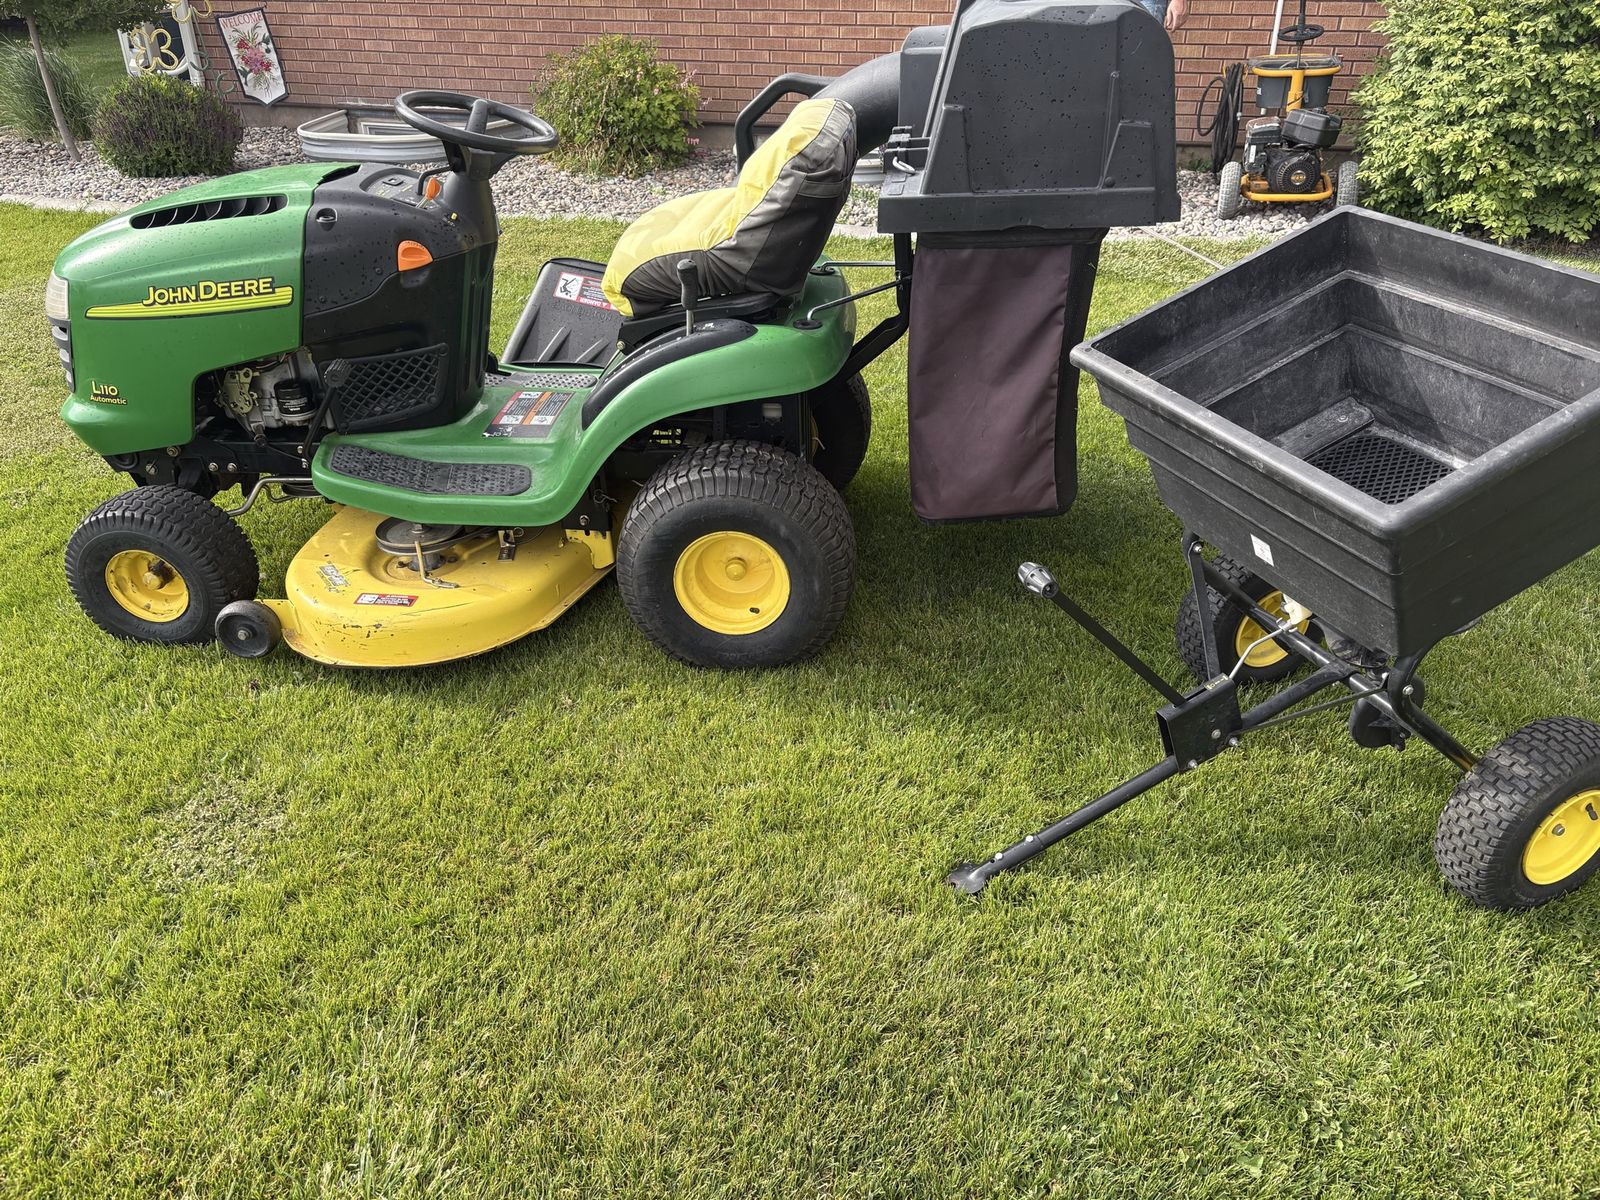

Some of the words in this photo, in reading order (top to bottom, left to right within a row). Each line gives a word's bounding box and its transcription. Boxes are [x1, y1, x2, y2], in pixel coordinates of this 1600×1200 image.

[221, 12, 263, 29] WELCOME
[142, 286, 196, 306] JOHN
[199, 277, 273, 300] DEERE
[91, 380, 118, 396] L110
[90, 394, 127, 405] Automatic
